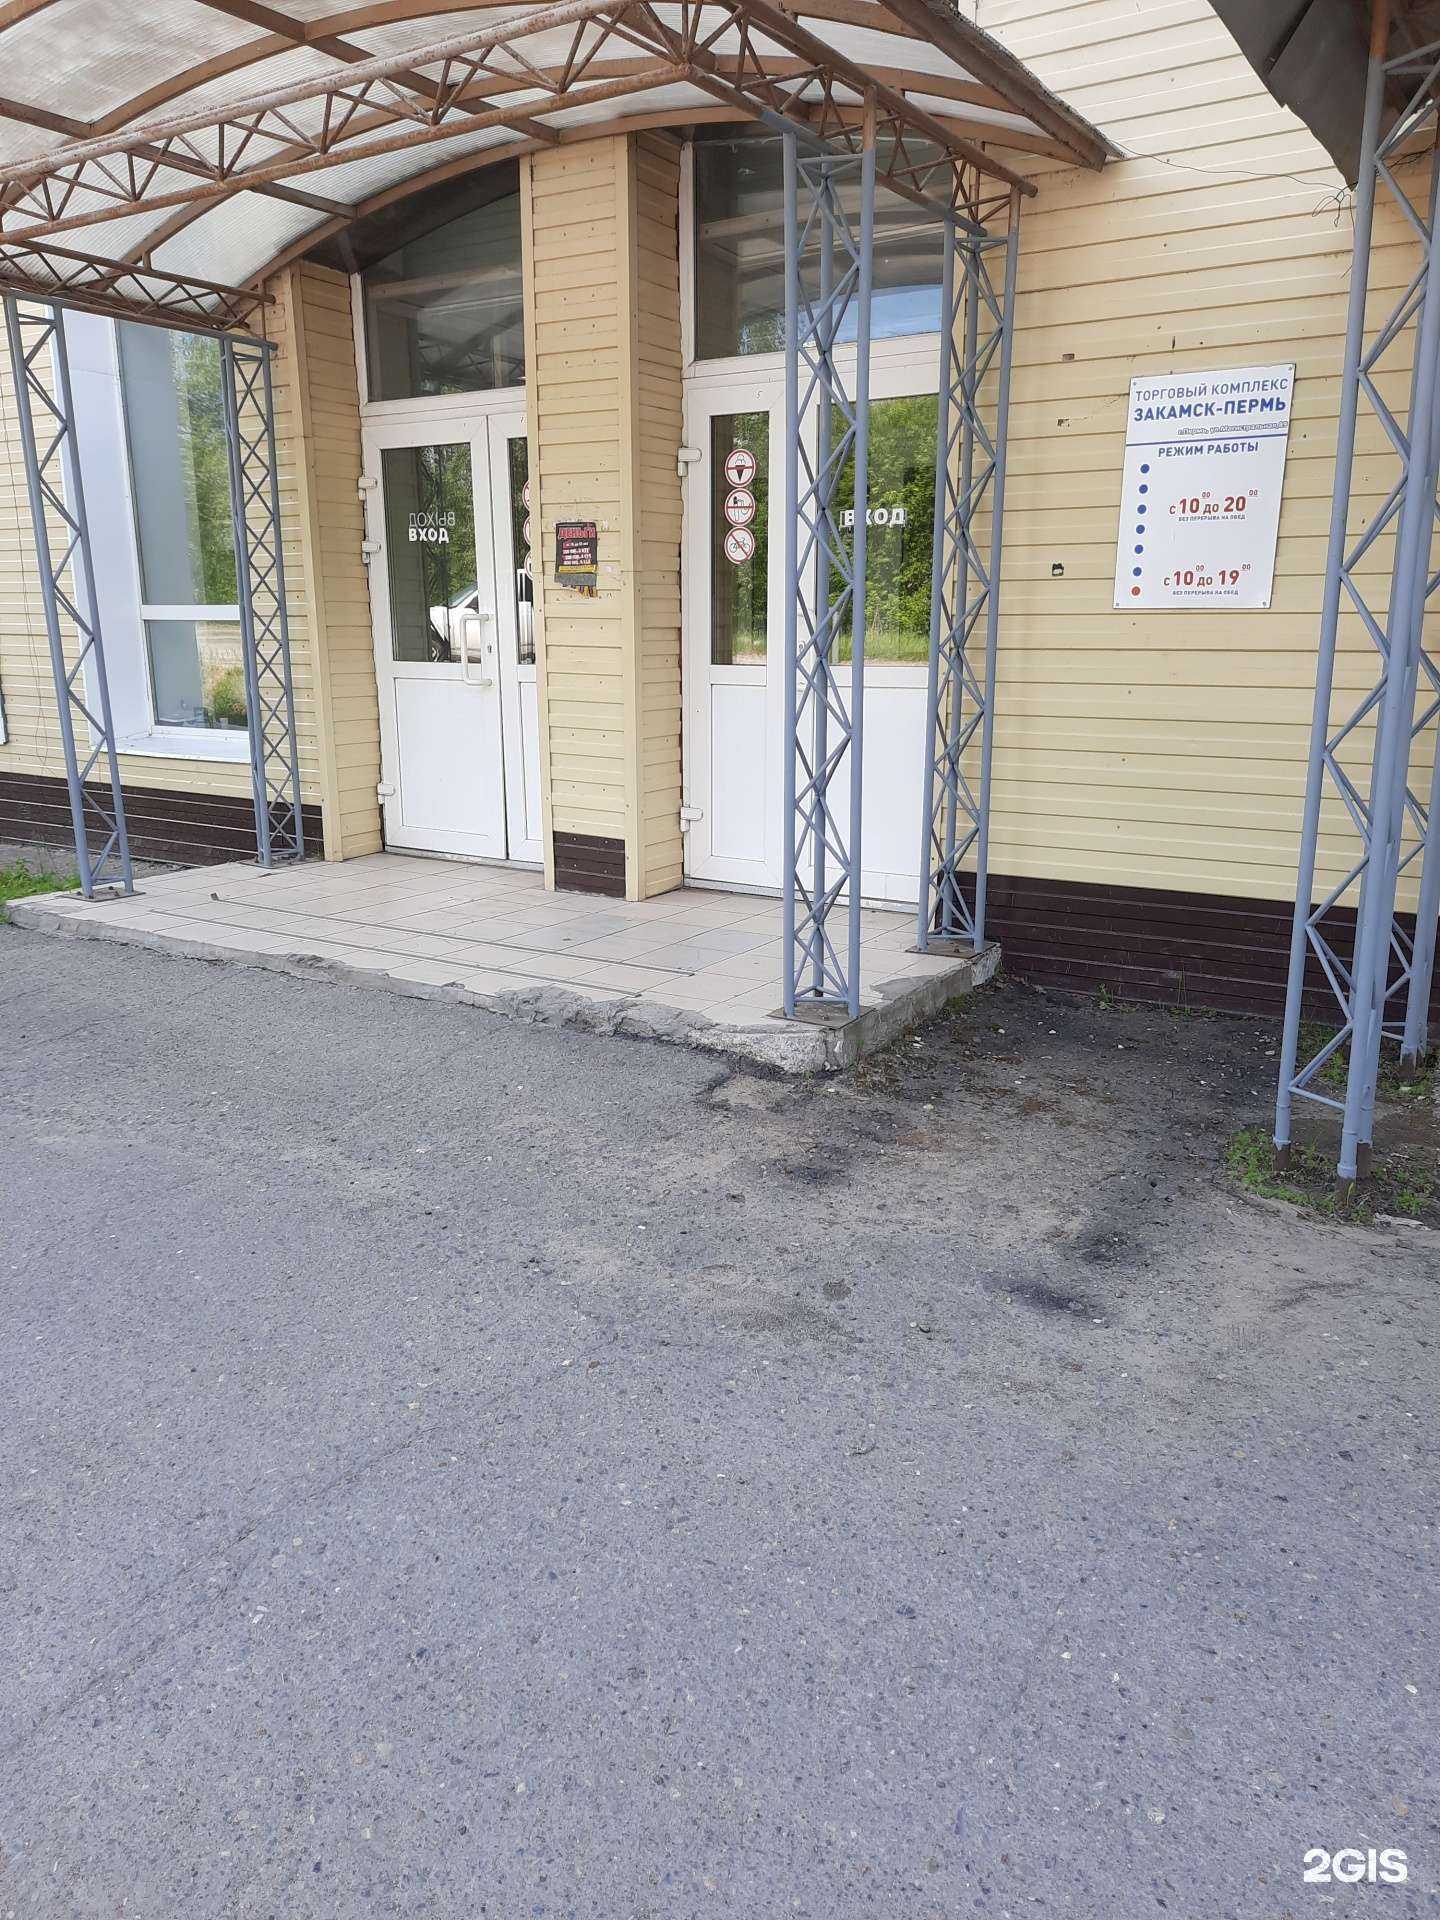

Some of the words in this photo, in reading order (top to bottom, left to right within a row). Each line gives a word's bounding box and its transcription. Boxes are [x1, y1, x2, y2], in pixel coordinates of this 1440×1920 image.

[1136, 383, 1206, 401] ТОРГОВЫЙ
[1212, 379, 1288, 395] КОМПЛЕКС
[1134, 397, 1286, 421] ЗАКАМСК-ПЕРМЬ
[1158, 445, 1203, 457] РЕЖИМ
[1207, 442, 1258, 455] РАБОТЫ
[1203, 503, 1219, 515] до
[409, 528, 449, 544] ВХОД
[1197, 577, 1213, 587] до
